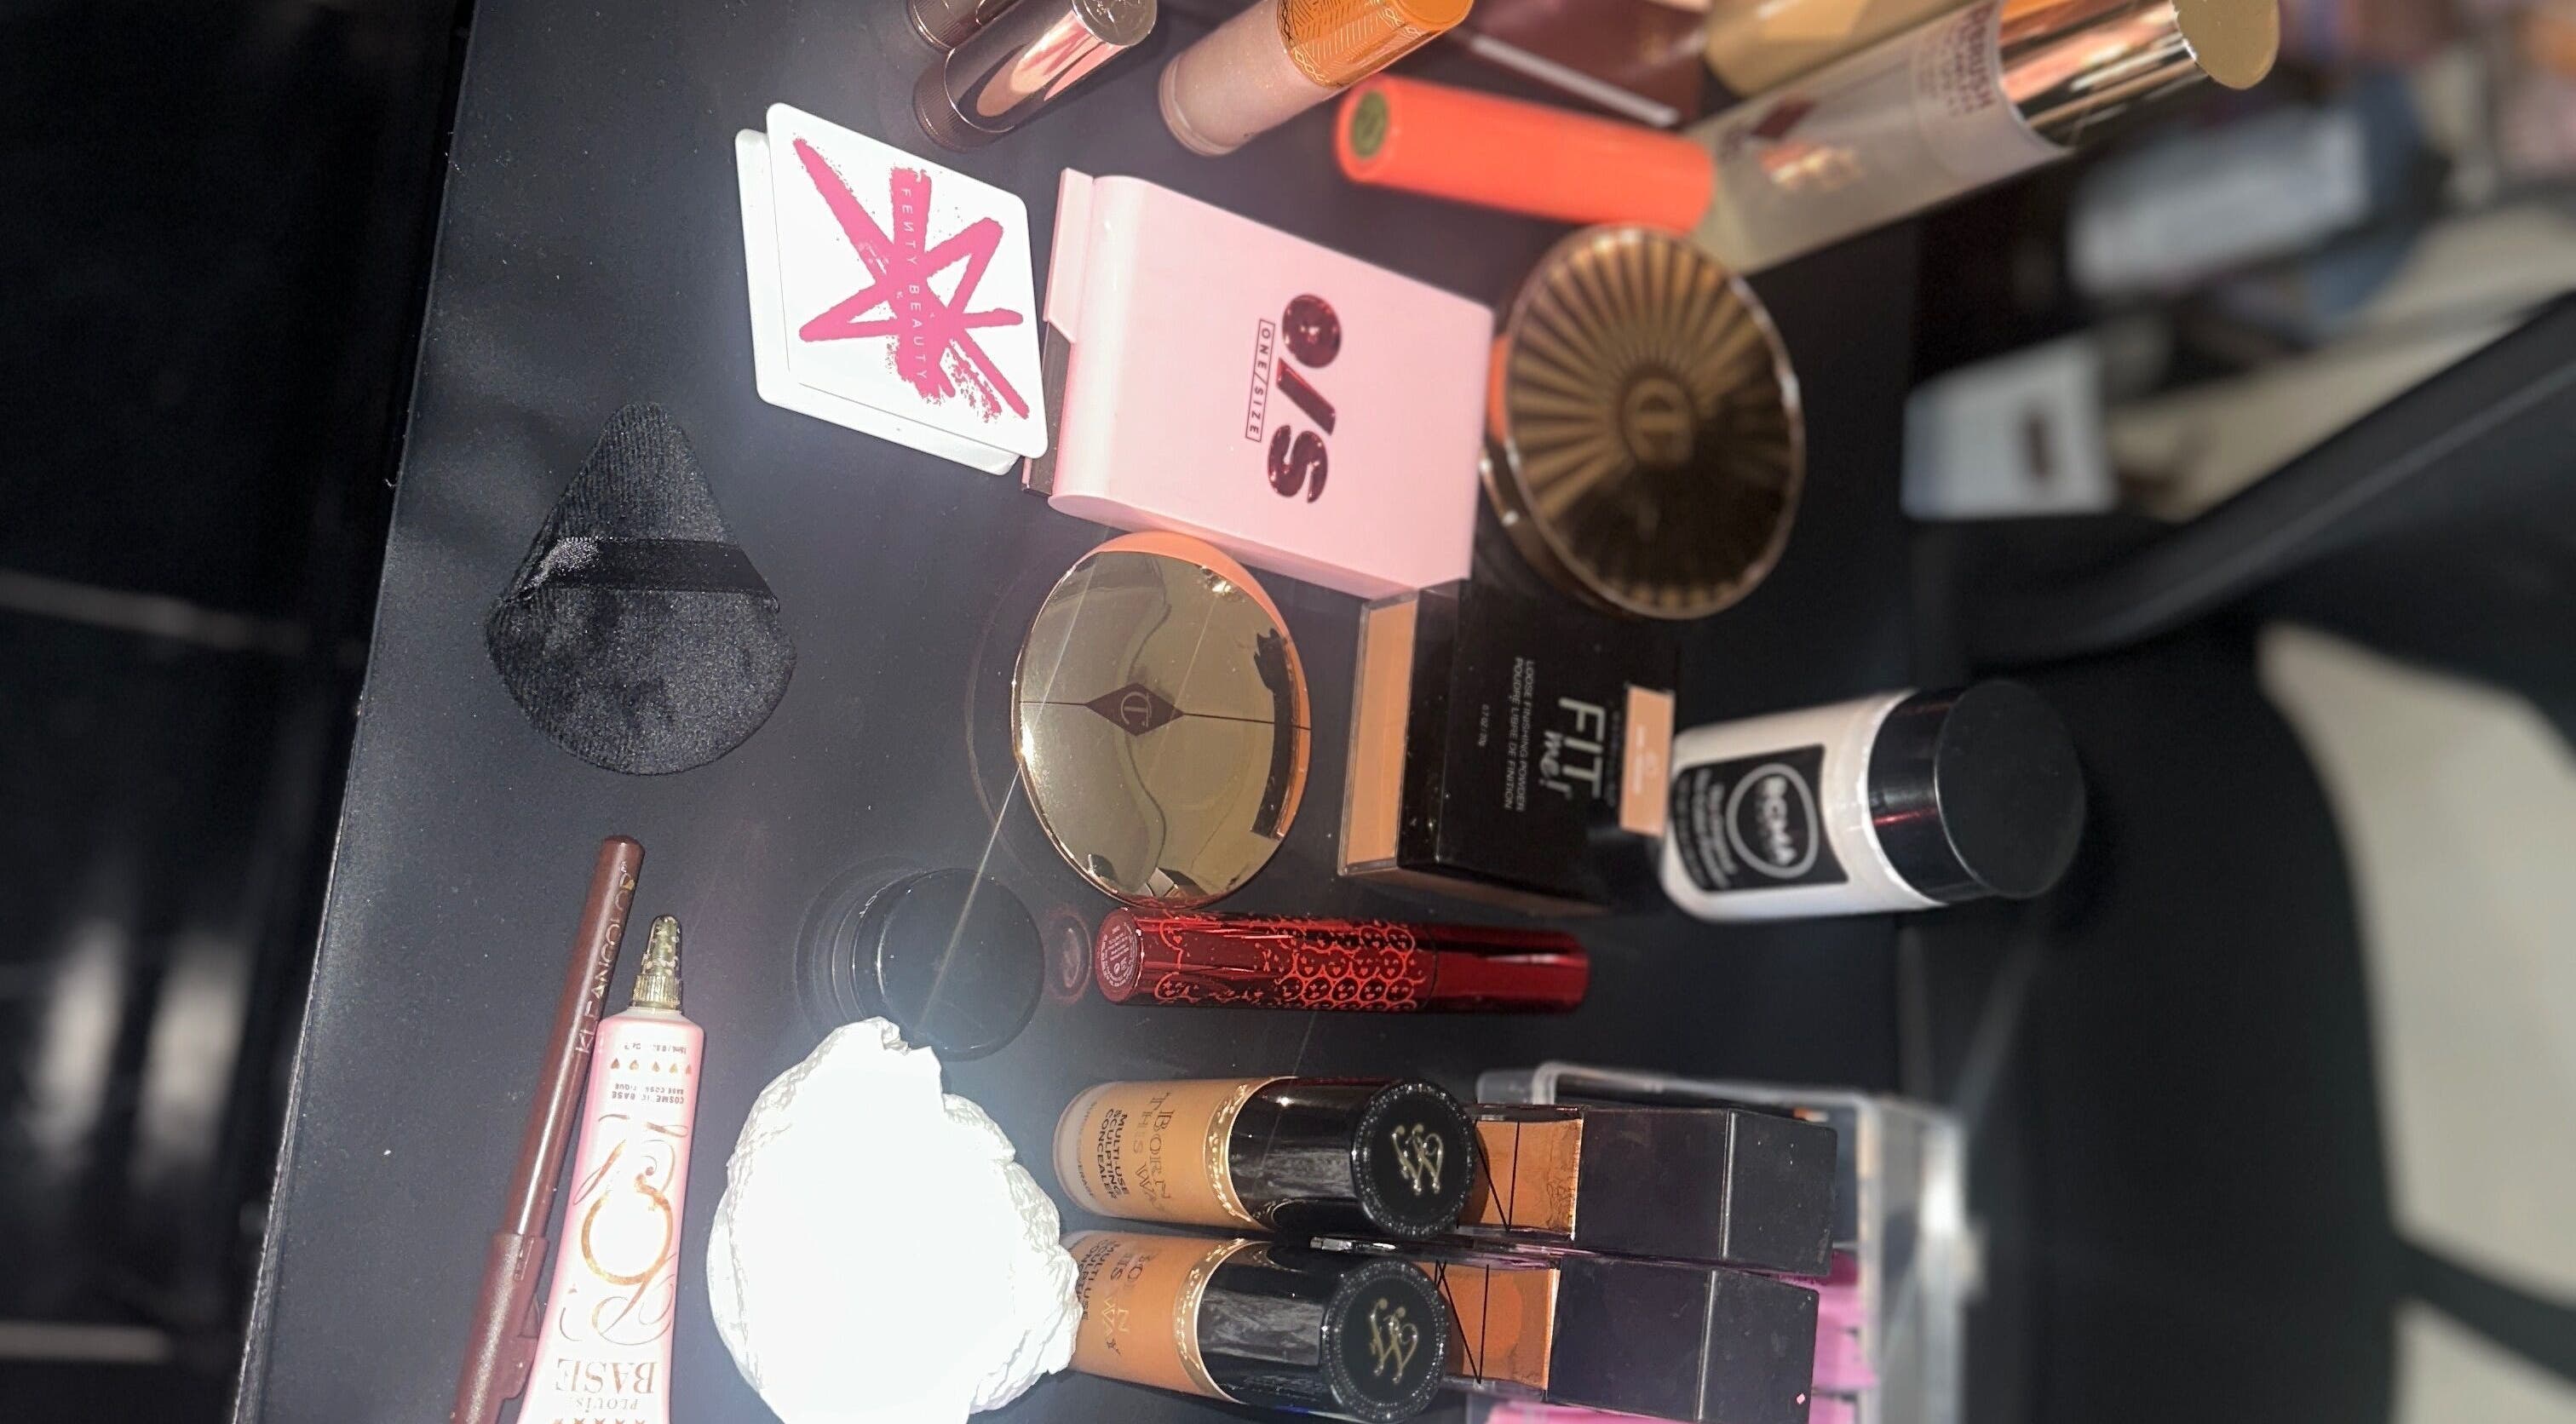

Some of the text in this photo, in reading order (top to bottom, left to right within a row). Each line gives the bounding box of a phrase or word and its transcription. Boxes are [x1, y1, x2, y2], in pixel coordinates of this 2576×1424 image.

[901, 187, 928, 381] FENTY BEAUTY
[1268, 294, 1342, 503] O/S
[1504, 657, 1524, 809] POUDRE LIBRE DE FINITION
[1515, 660, 1535, 812] LOOSE FINISHING POWDER
[1539, 730, 1573, 795] me!
[1558, 698, 1606, 798] FIT
[1097, 1108, 1118, 1200] CONCEALER
[1105, 1109, 1123, 1196] SCULPTING
[552, 1358, 658, 1395] BASE
